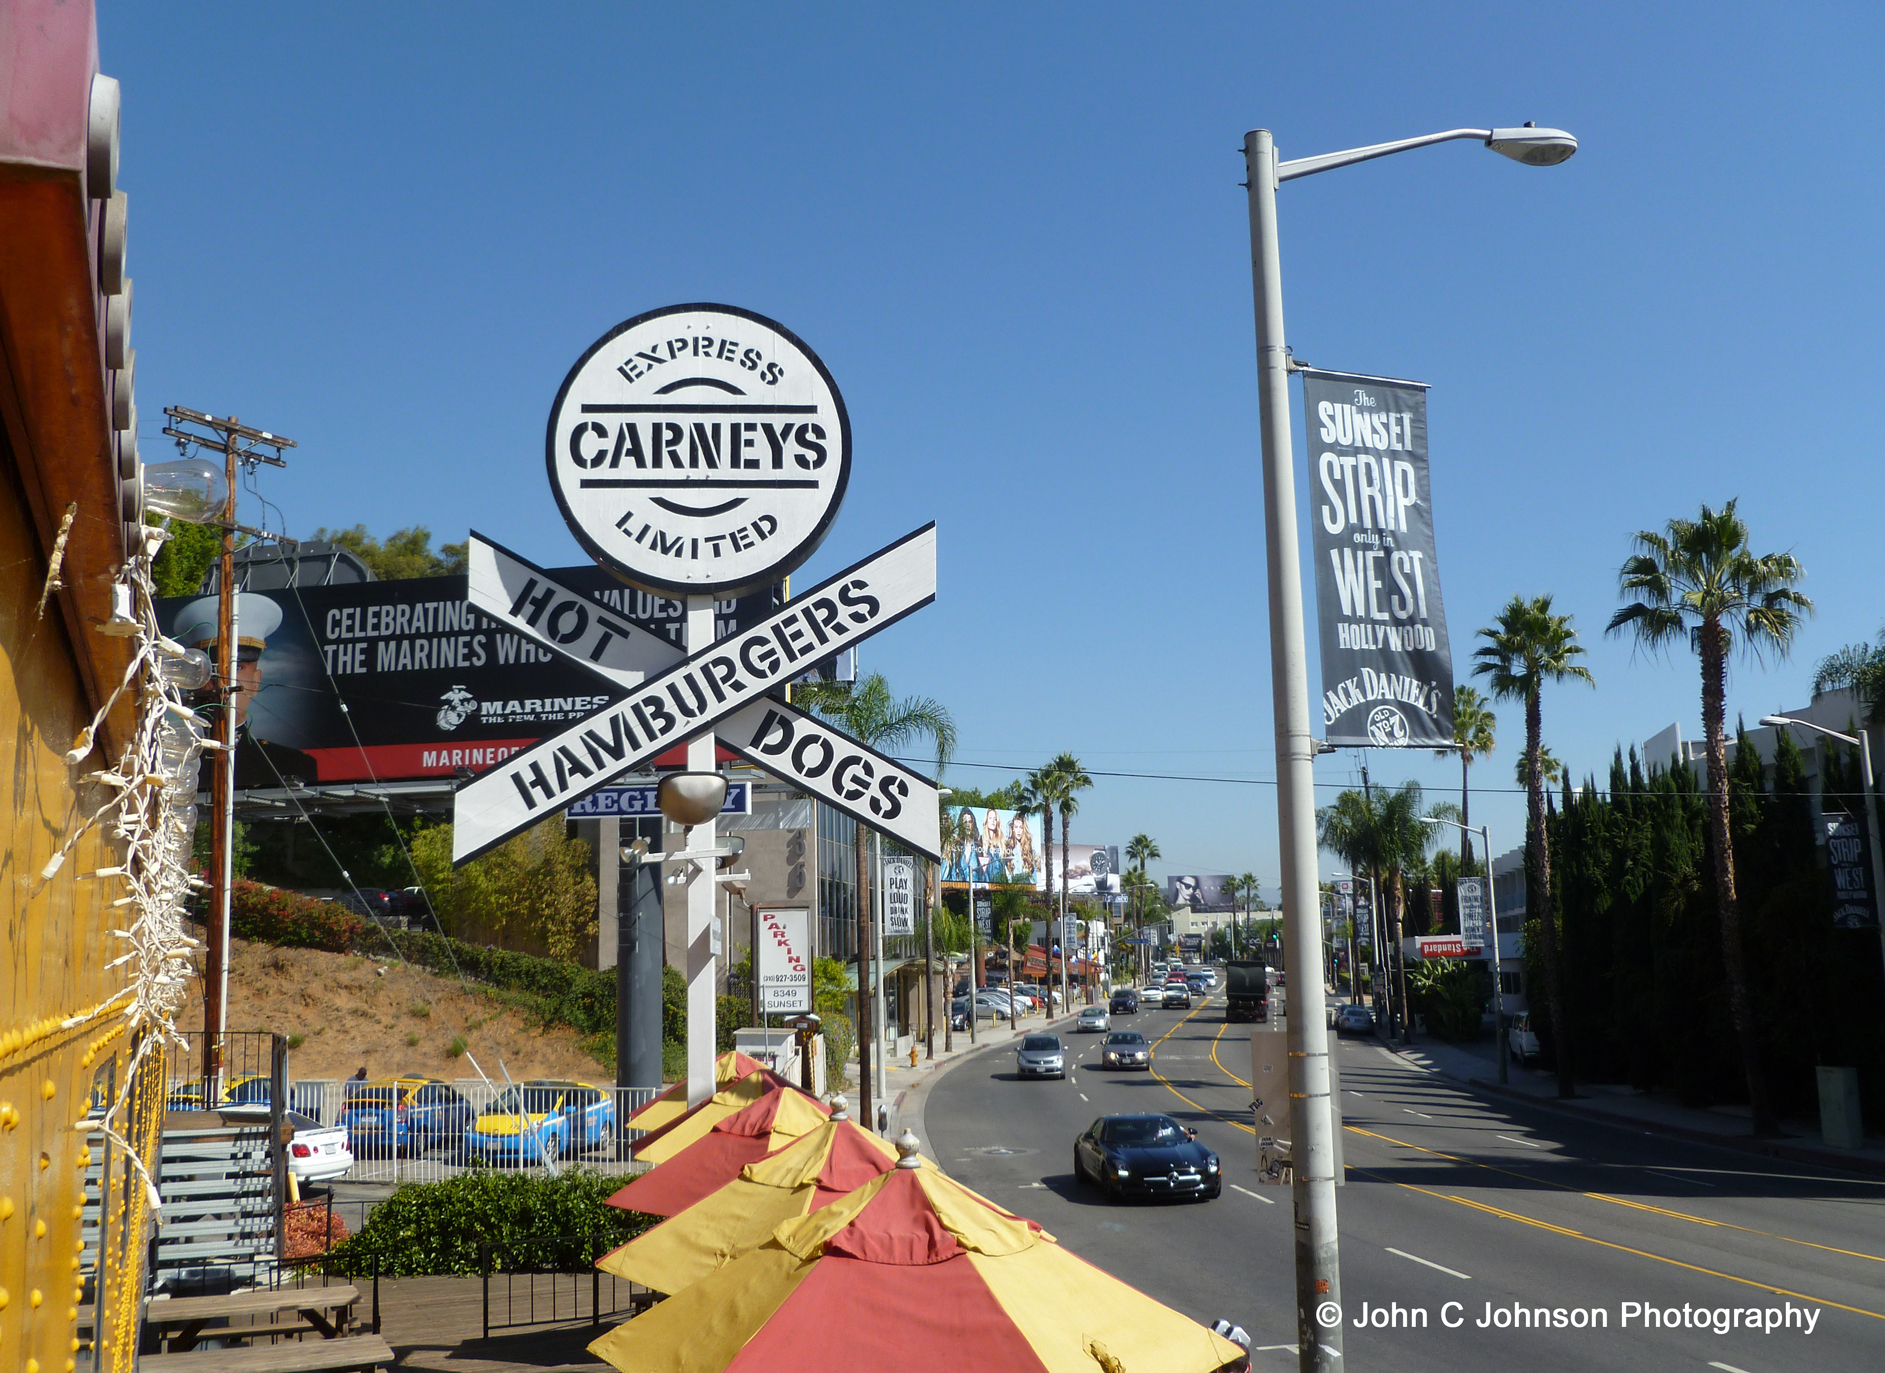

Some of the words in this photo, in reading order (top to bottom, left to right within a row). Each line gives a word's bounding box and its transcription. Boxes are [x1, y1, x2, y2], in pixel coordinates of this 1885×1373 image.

[616, 336, 785, 386] EXPRESS
[1354, 389, 1377, 407] The
[1318, 401, 1414, 451] SUNSET
[568, 421, 828, 471] CARNEYS
[1319, 452, 1416, 535] STRIP
[614, 510, 779, 560] LIMITED
[1353, 533, 1380, 550] only
[1382, 533, 1395, 547] in
[1330, 547, 1428, 620] WEST
[326, 601, 475, 640] CELEBRATING
[1337, 622, 1436, 651] HOLLYWOOD
[324, 642, 368, 675] THE
[376, 635, 487, 672] MARINES
[480, 695, 610, 716] MARINES
[508, 577, 631, 664] HOT
[749, 708, 910, 820] DOGS
[509, 578, 882, 812] HAMBURGERS
[1323, 676, 1366, 726] JACK
[480, 715, 505, 724] THE
[540, 711, 565, 721] THE
[1374, 709, 1390, 722] OLD
[1829, 838, 1862, 865] STRIP
[889, 878, 908, 890] PLAY
[1833, 867, 1864, 890] WEST
[889, 892, 908, 904] LOUD
[890, 916, 909, 927] SLOW
[763, 914, 806, 972] PARKING
[1424, 944, 1462, 953] Standard
[775, 974, 806, 983] 927-3509
[767, 1000, 803, 1008] SUNSET
[773, 989, 797, 997] 8349
